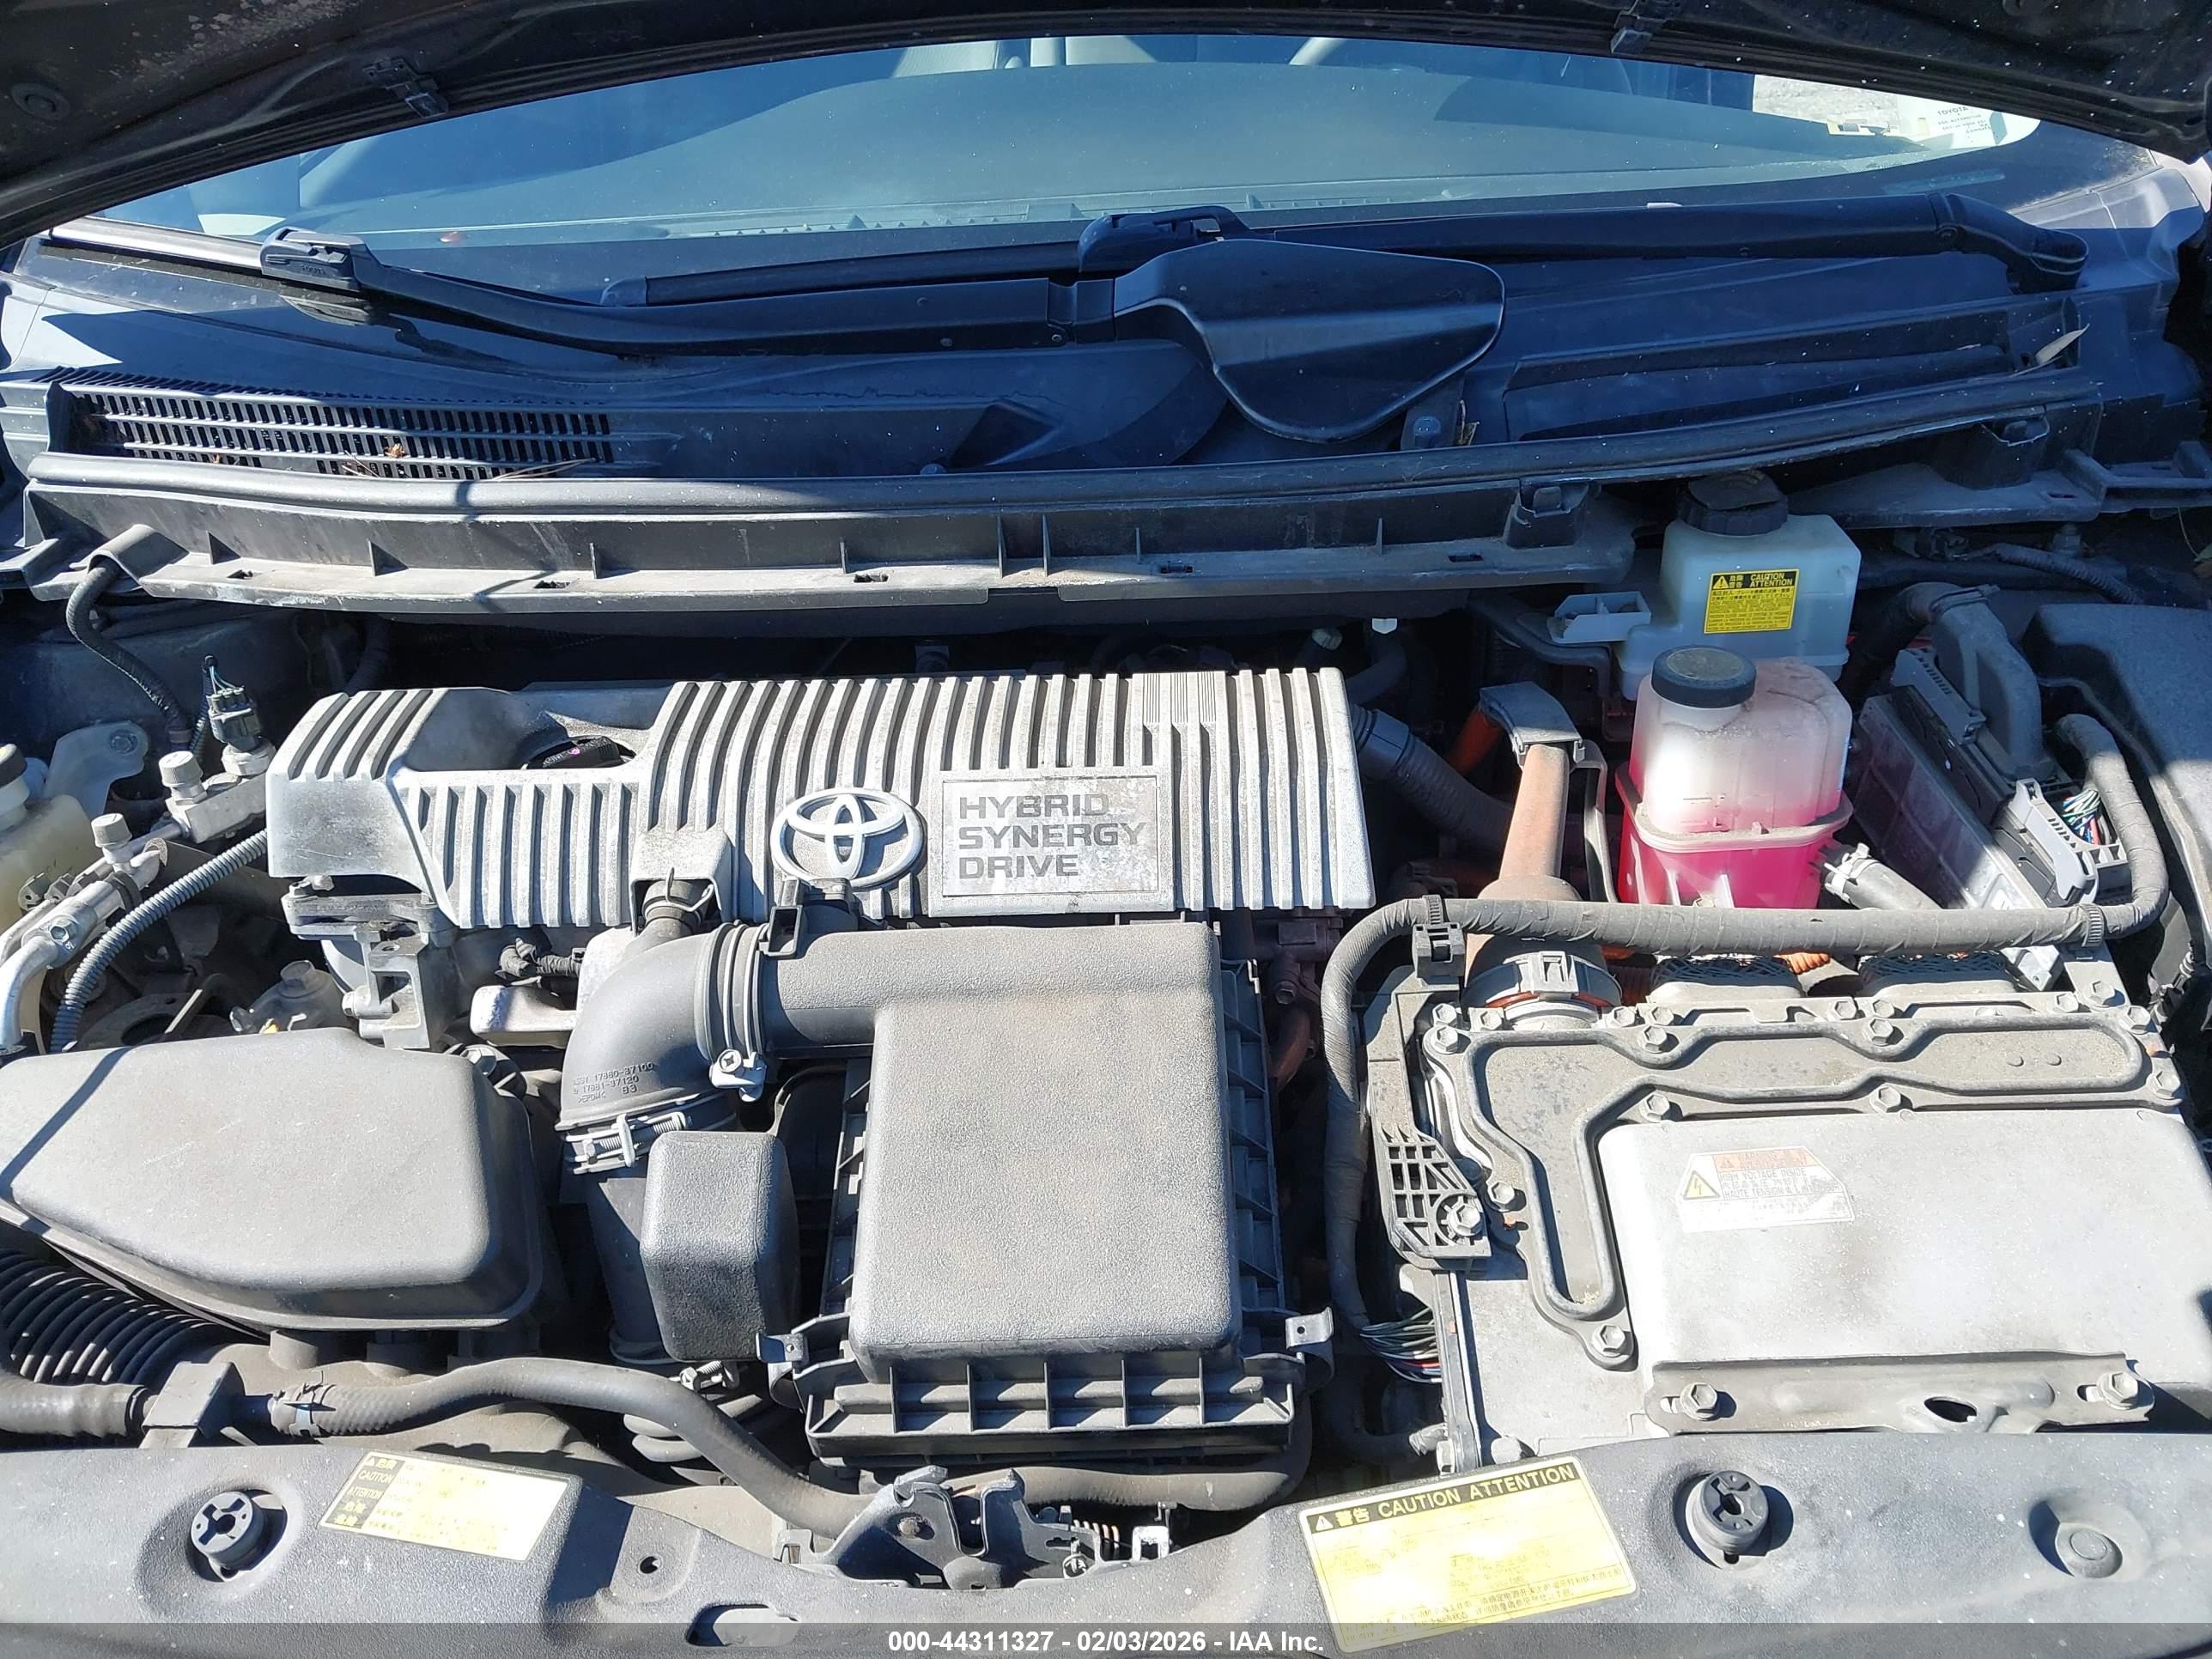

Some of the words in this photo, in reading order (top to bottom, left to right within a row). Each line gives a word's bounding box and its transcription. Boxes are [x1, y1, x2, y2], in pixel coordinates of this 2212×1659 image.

[1937, 106, 1969, 115] TOYOTA
[1749, 579, 1793, 588] ATTENTION
[1750, 572, 1785, 581] CAUTION
[959, 793, 1109, 820] HYBRID
[958, 822, 1146, 850] SYNERGY
[958, 854, 1079, 879] DRIVE
[1720, 1173, 1739, 1182] HIGH
[1742, 1170, 1778, 1180] VOLTAGE
[1781, 1168, 1808, 1178] INSIDE
[1724, 1188, 1750, 1198] HAUTE
[1752, 1187, 1785, 1197] TENSION
[358, 1469, 394, 1484] CAUTION
[346, 1486, 384, 1499] ATTENTION
[1378, 1487, 1462, 1518] CAUTION
[1469, 1465, 1576, 1498] ATTENTION
